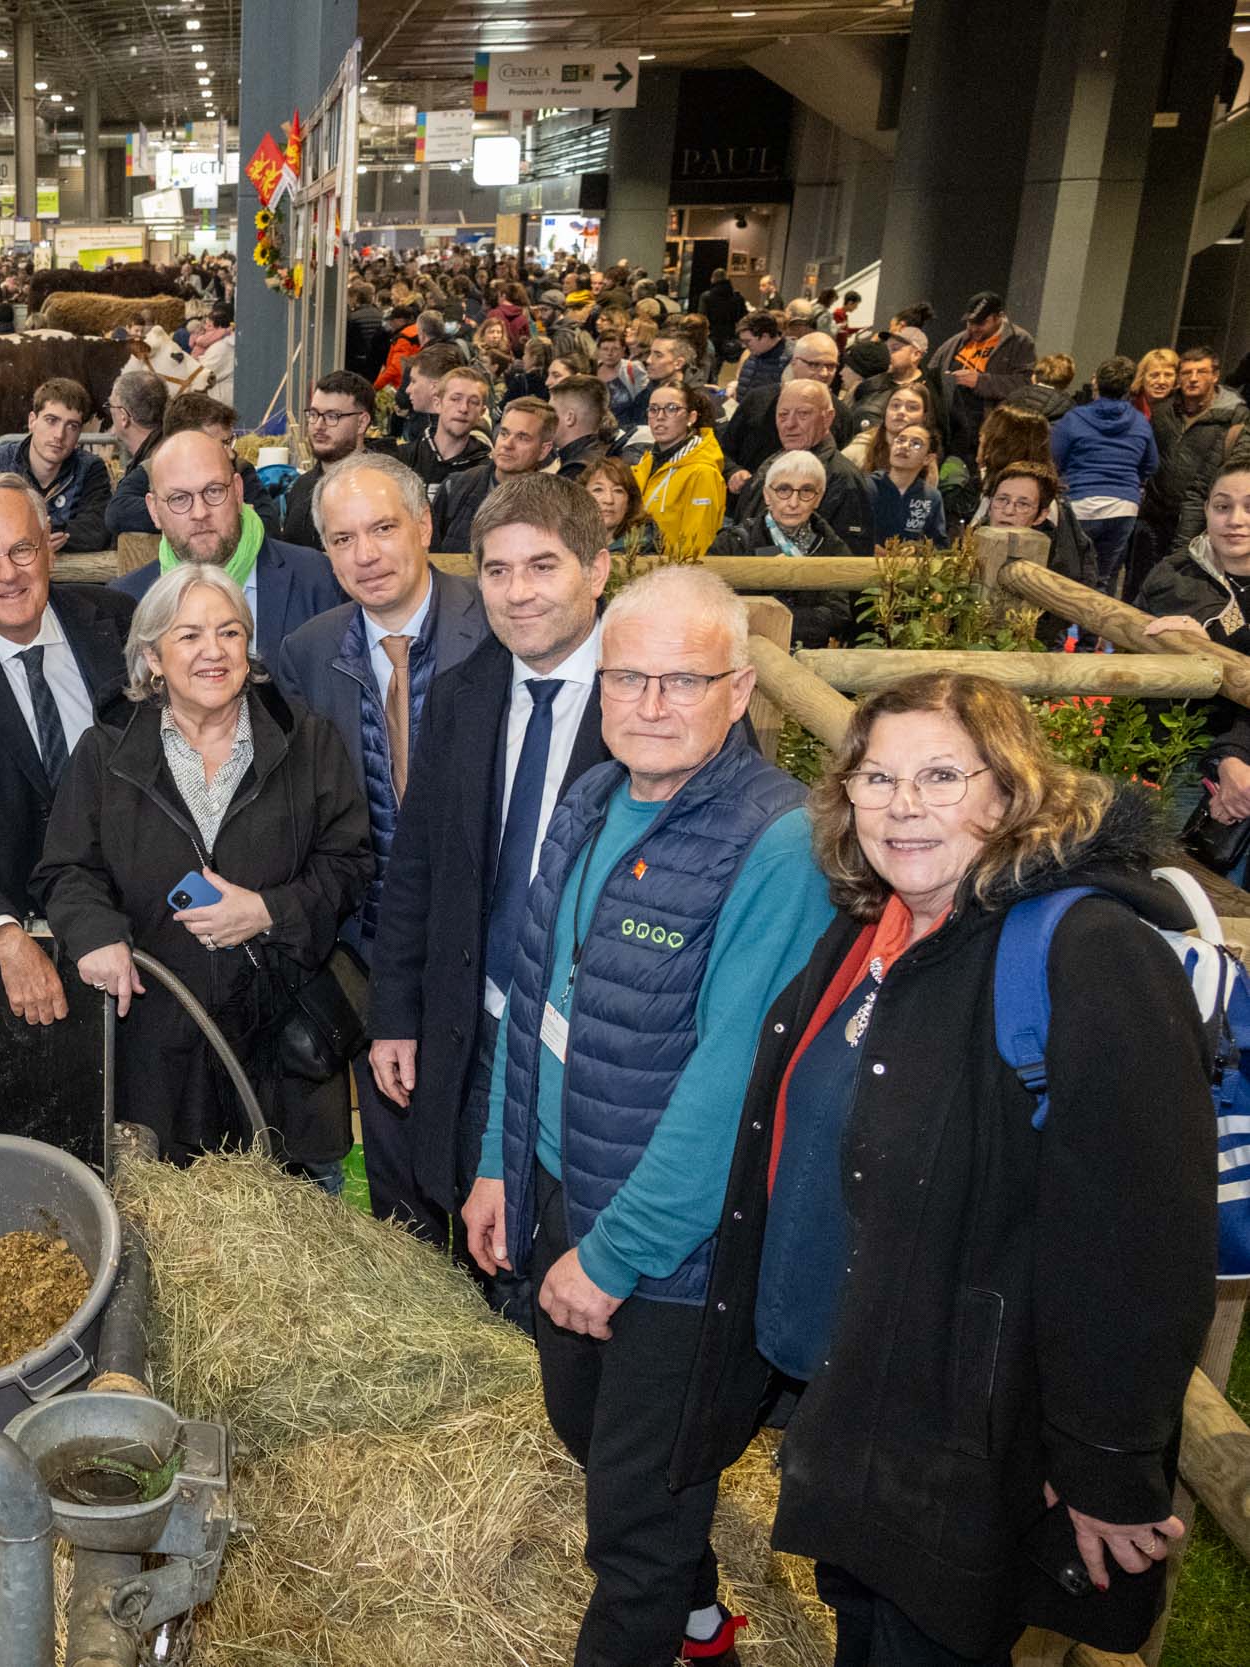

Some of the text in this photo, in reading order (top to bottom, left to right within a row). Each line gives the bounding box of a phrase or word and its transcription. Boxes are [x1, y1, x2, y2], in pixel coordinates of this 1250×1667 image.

[501, 66, 550, 79] CENECA
[508, 88, 544, 96] Protocole
[681, 147, 778, 175] PAUL
[910, 499, 932, 512] LOVE
